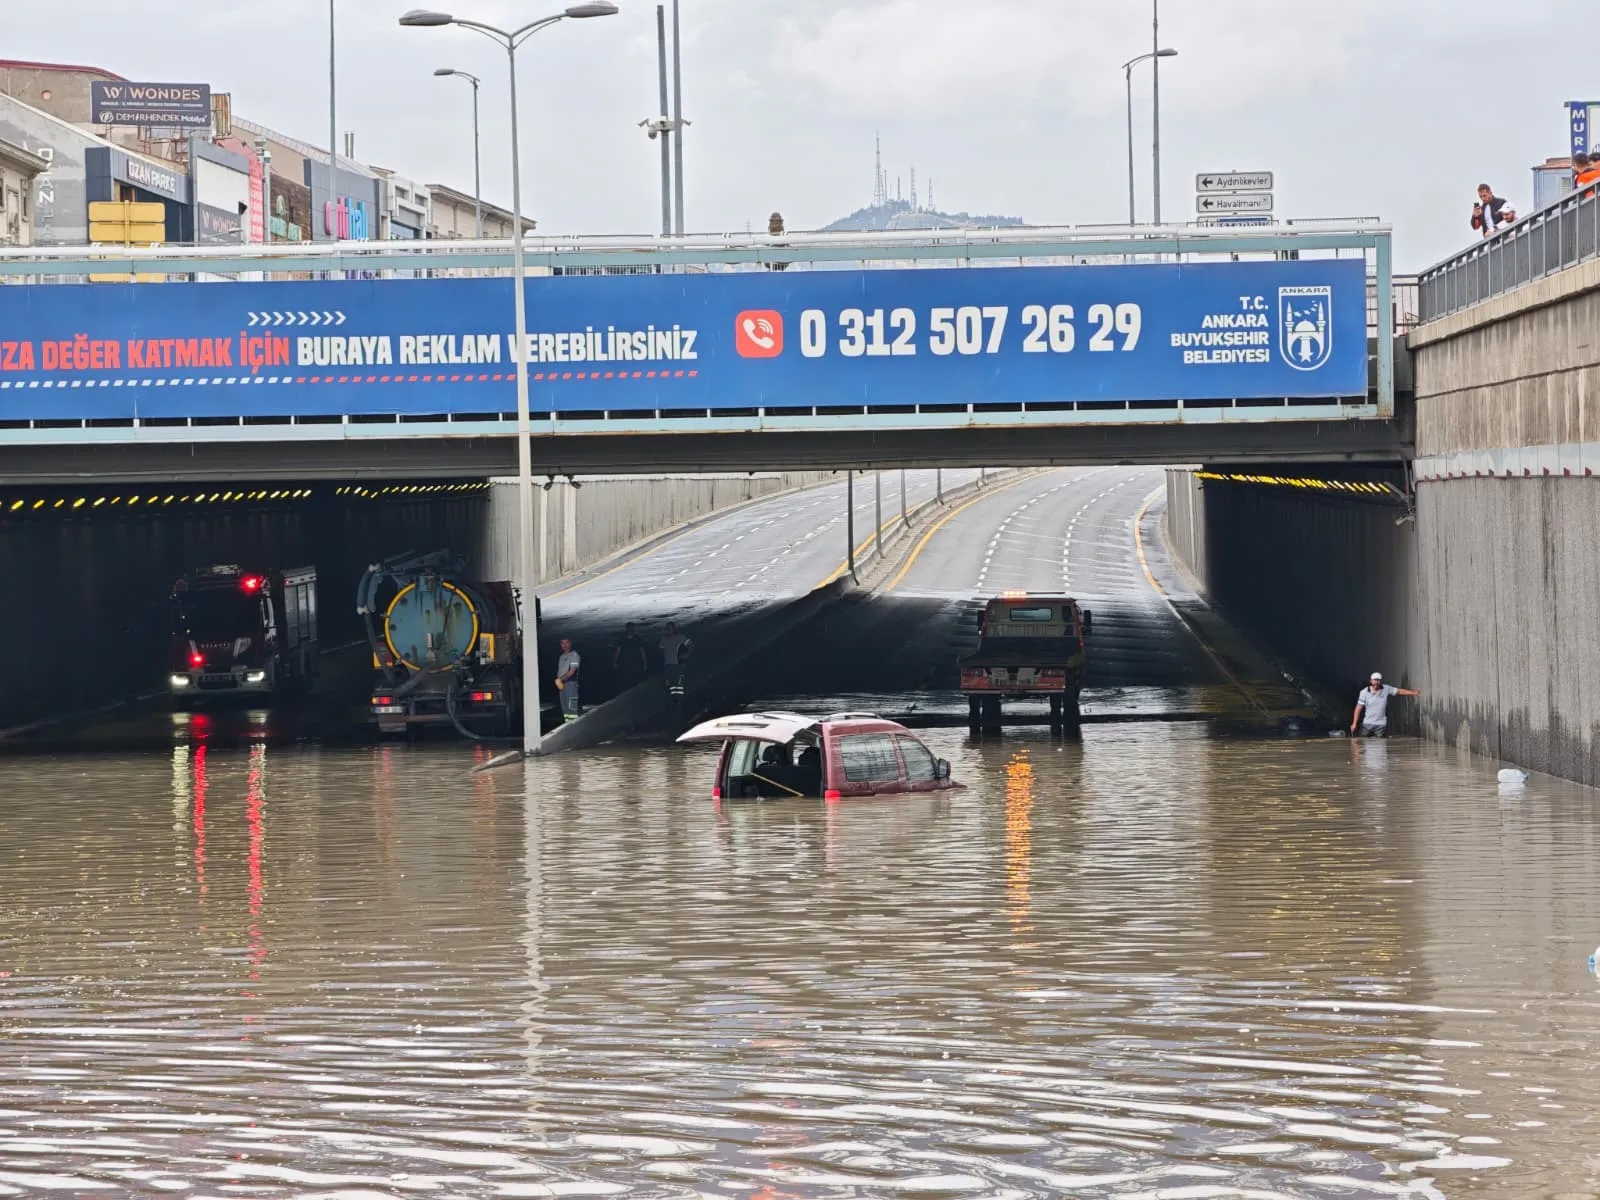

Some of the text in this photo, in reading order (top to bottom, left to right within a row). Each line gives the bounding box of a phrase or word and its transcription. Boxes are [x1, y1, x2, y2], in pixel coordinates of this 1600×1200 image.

[129, 87, 201, 100] WONDES
[1240, 296, 1269, 310] T.C.
[1201, 312, 1269, 329] ANKARA
[800, 303, 1142, 358] 0 312 507 26 29
[0, 340, 35, 370] ZA
[42, 332, 121, 370] DEĞER
[127, 337, 233, 369] KATMAK
[239, 330, 290, 375] İÇİN
[297, 335, 393, 366] BURAYA
[399, 334, 500, 364] REKLAM
